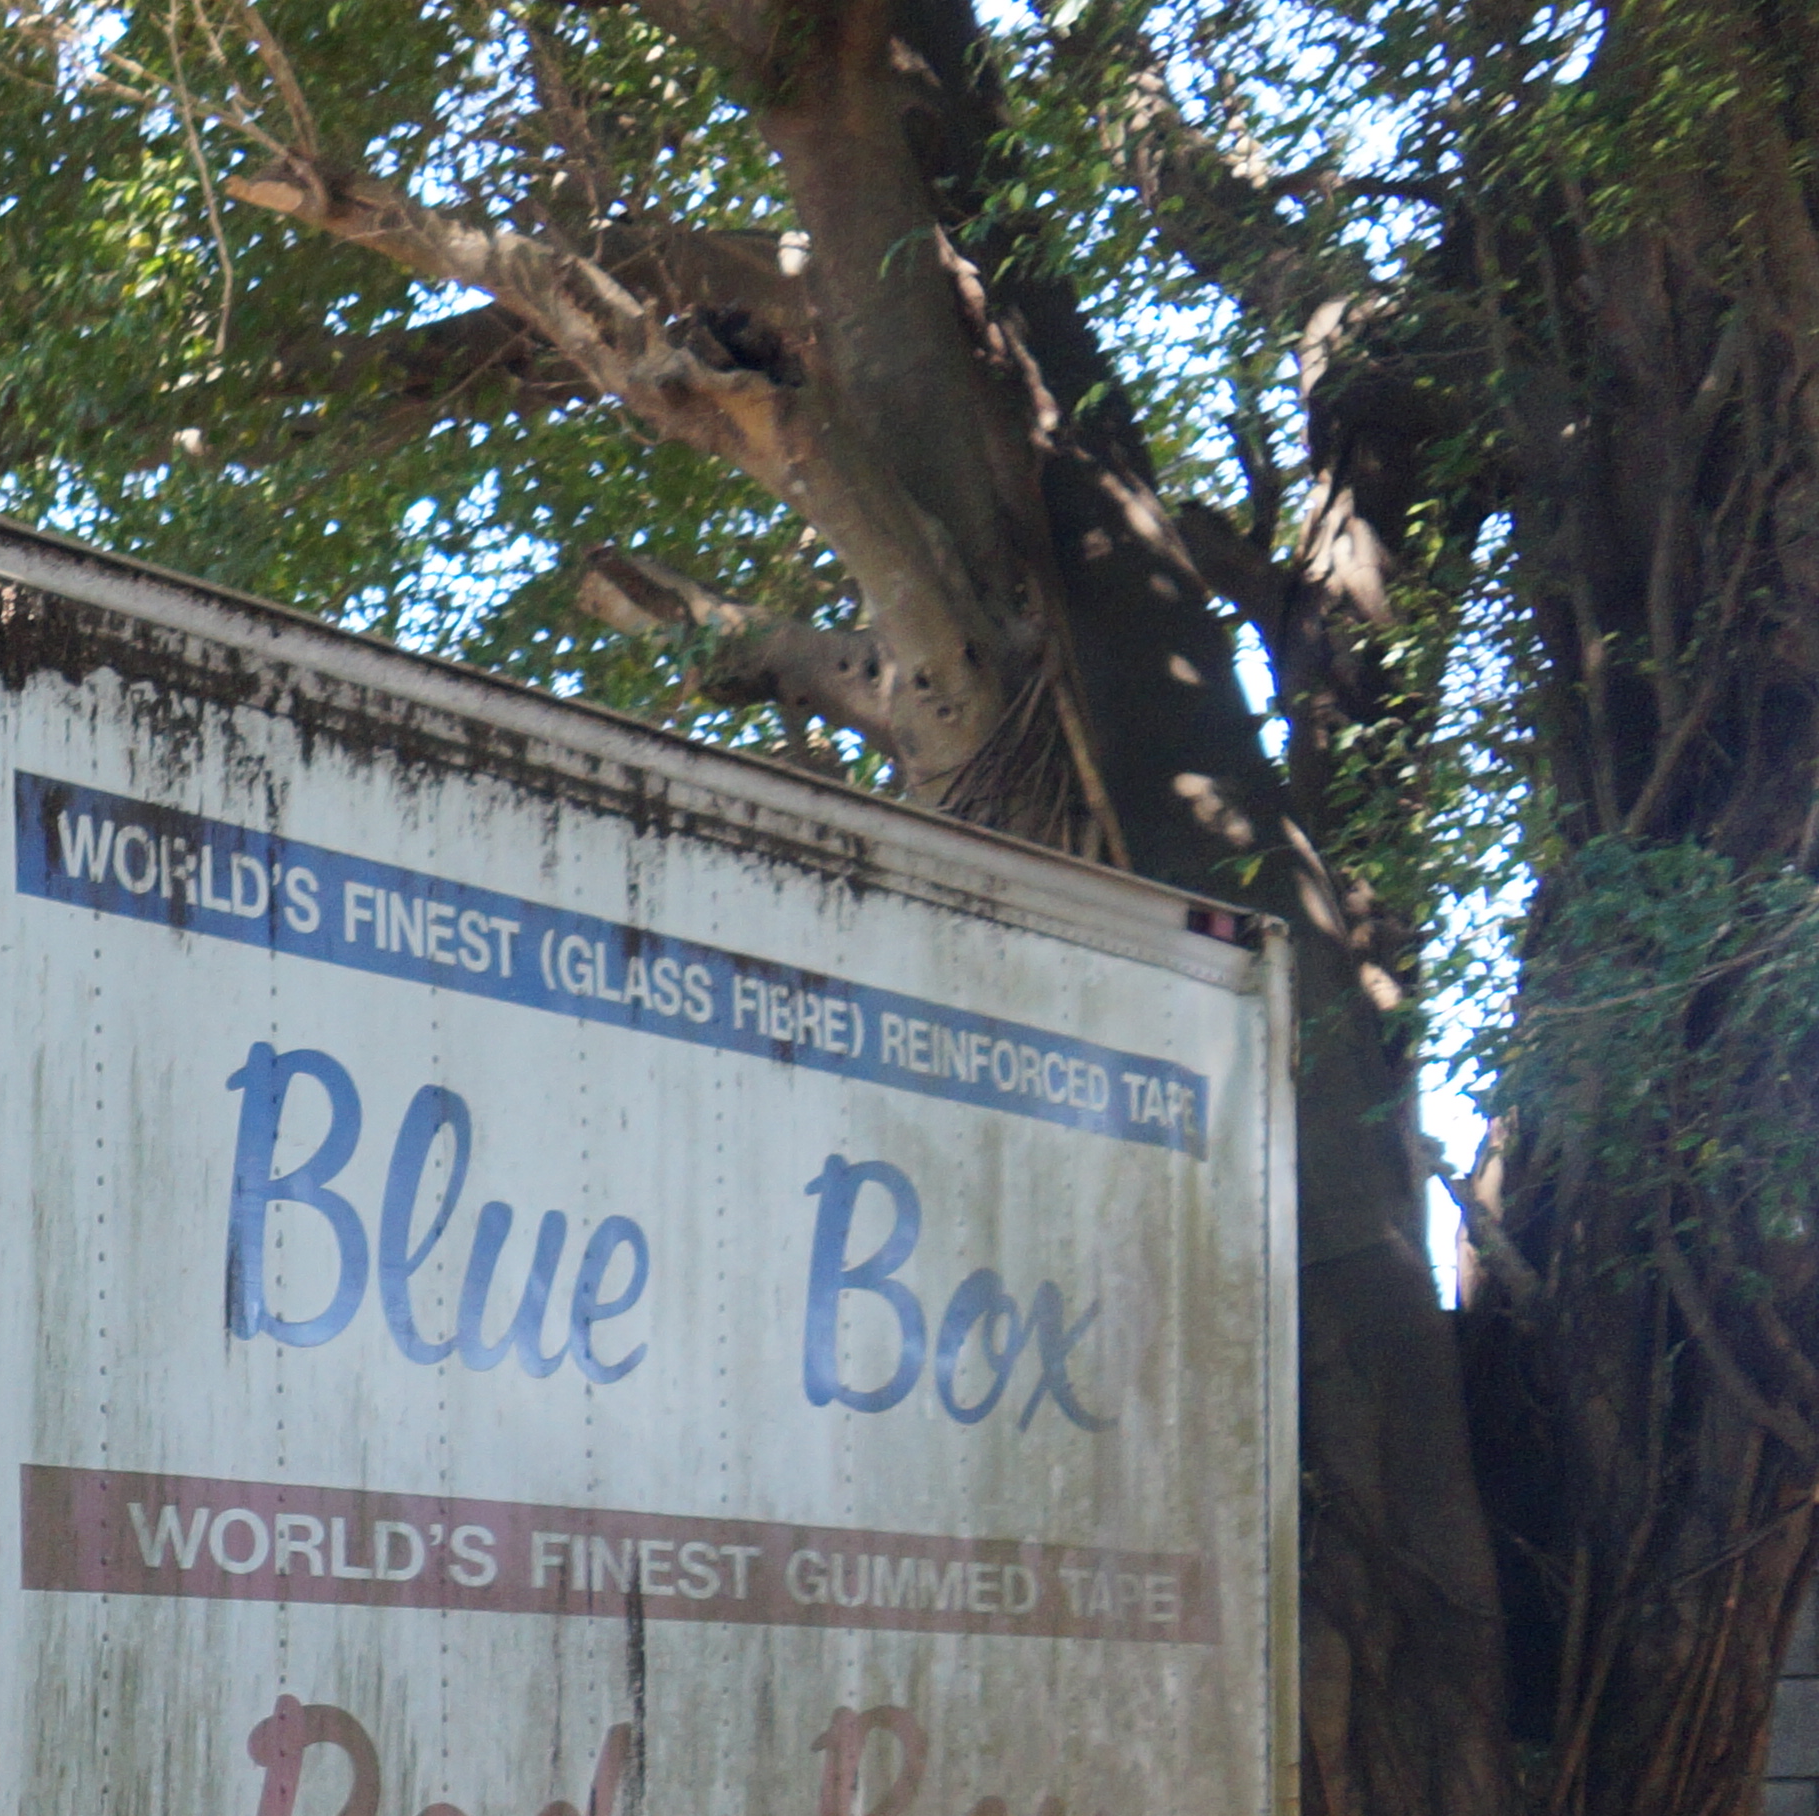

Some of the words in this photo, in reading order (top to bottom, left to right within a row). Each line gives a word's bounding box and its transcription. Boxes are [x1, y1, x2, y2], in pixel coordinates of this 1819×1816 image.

[57, 810, 321, 934] WORLD'S
[343, 881, 520, 978] FINEST
[541, 929, 713, 1024] (GLASS
[732, 975, 863, 1058] FIBRE)
[881, 1014, 1109, 1112] REINFORCED
[1121, 1072, 1200, 1138] TAPE
[225, 1041, 649, 1386] Blue
[801, 1153, 1121, 1433] Box
[128, 1501, 498, 1588] WORLD'S
[531, 1532, 760, 1600] FINEST
[784, 1550, 1040, 1615] GUMMED
[1058, 1568, 1180, 1623] TAPE
